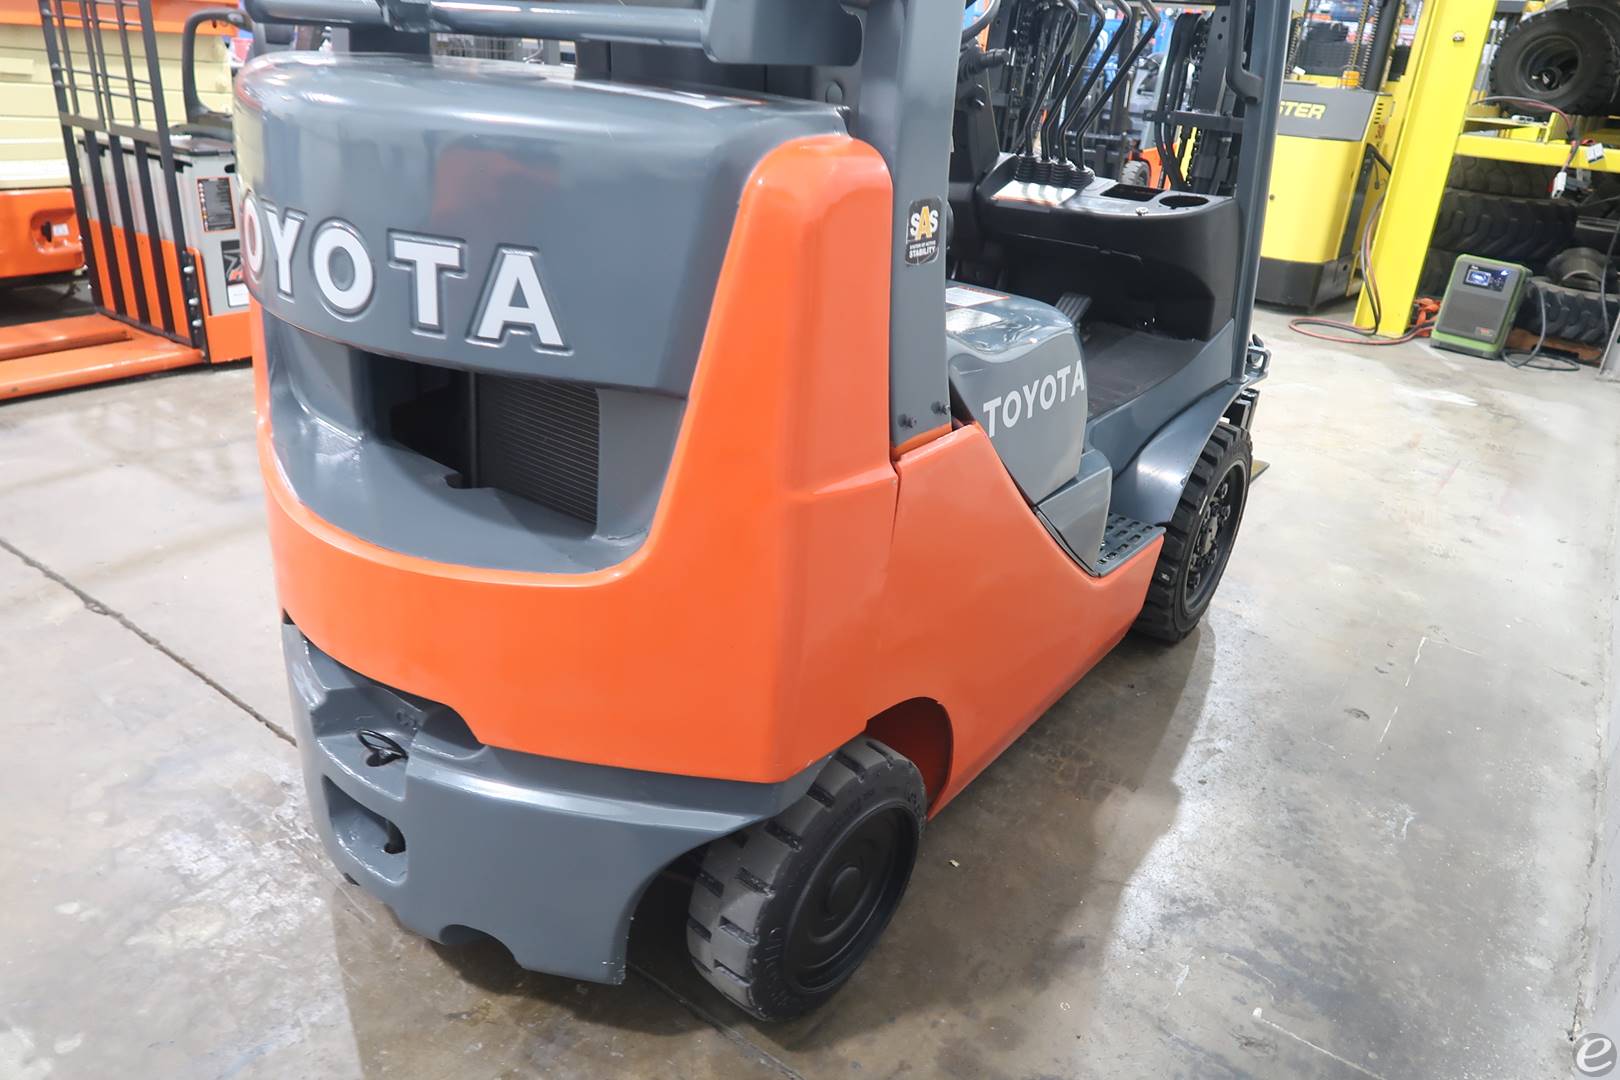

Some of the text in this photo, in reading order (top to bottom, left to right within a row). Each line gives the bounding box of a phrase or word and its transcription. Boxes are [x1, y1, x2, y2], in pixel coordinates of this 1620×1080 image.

[910, 206, 939, 241] SAS
[909, 246, 936, 258] STABILITY
[983, 360, 1085, 437] TOYOTA
